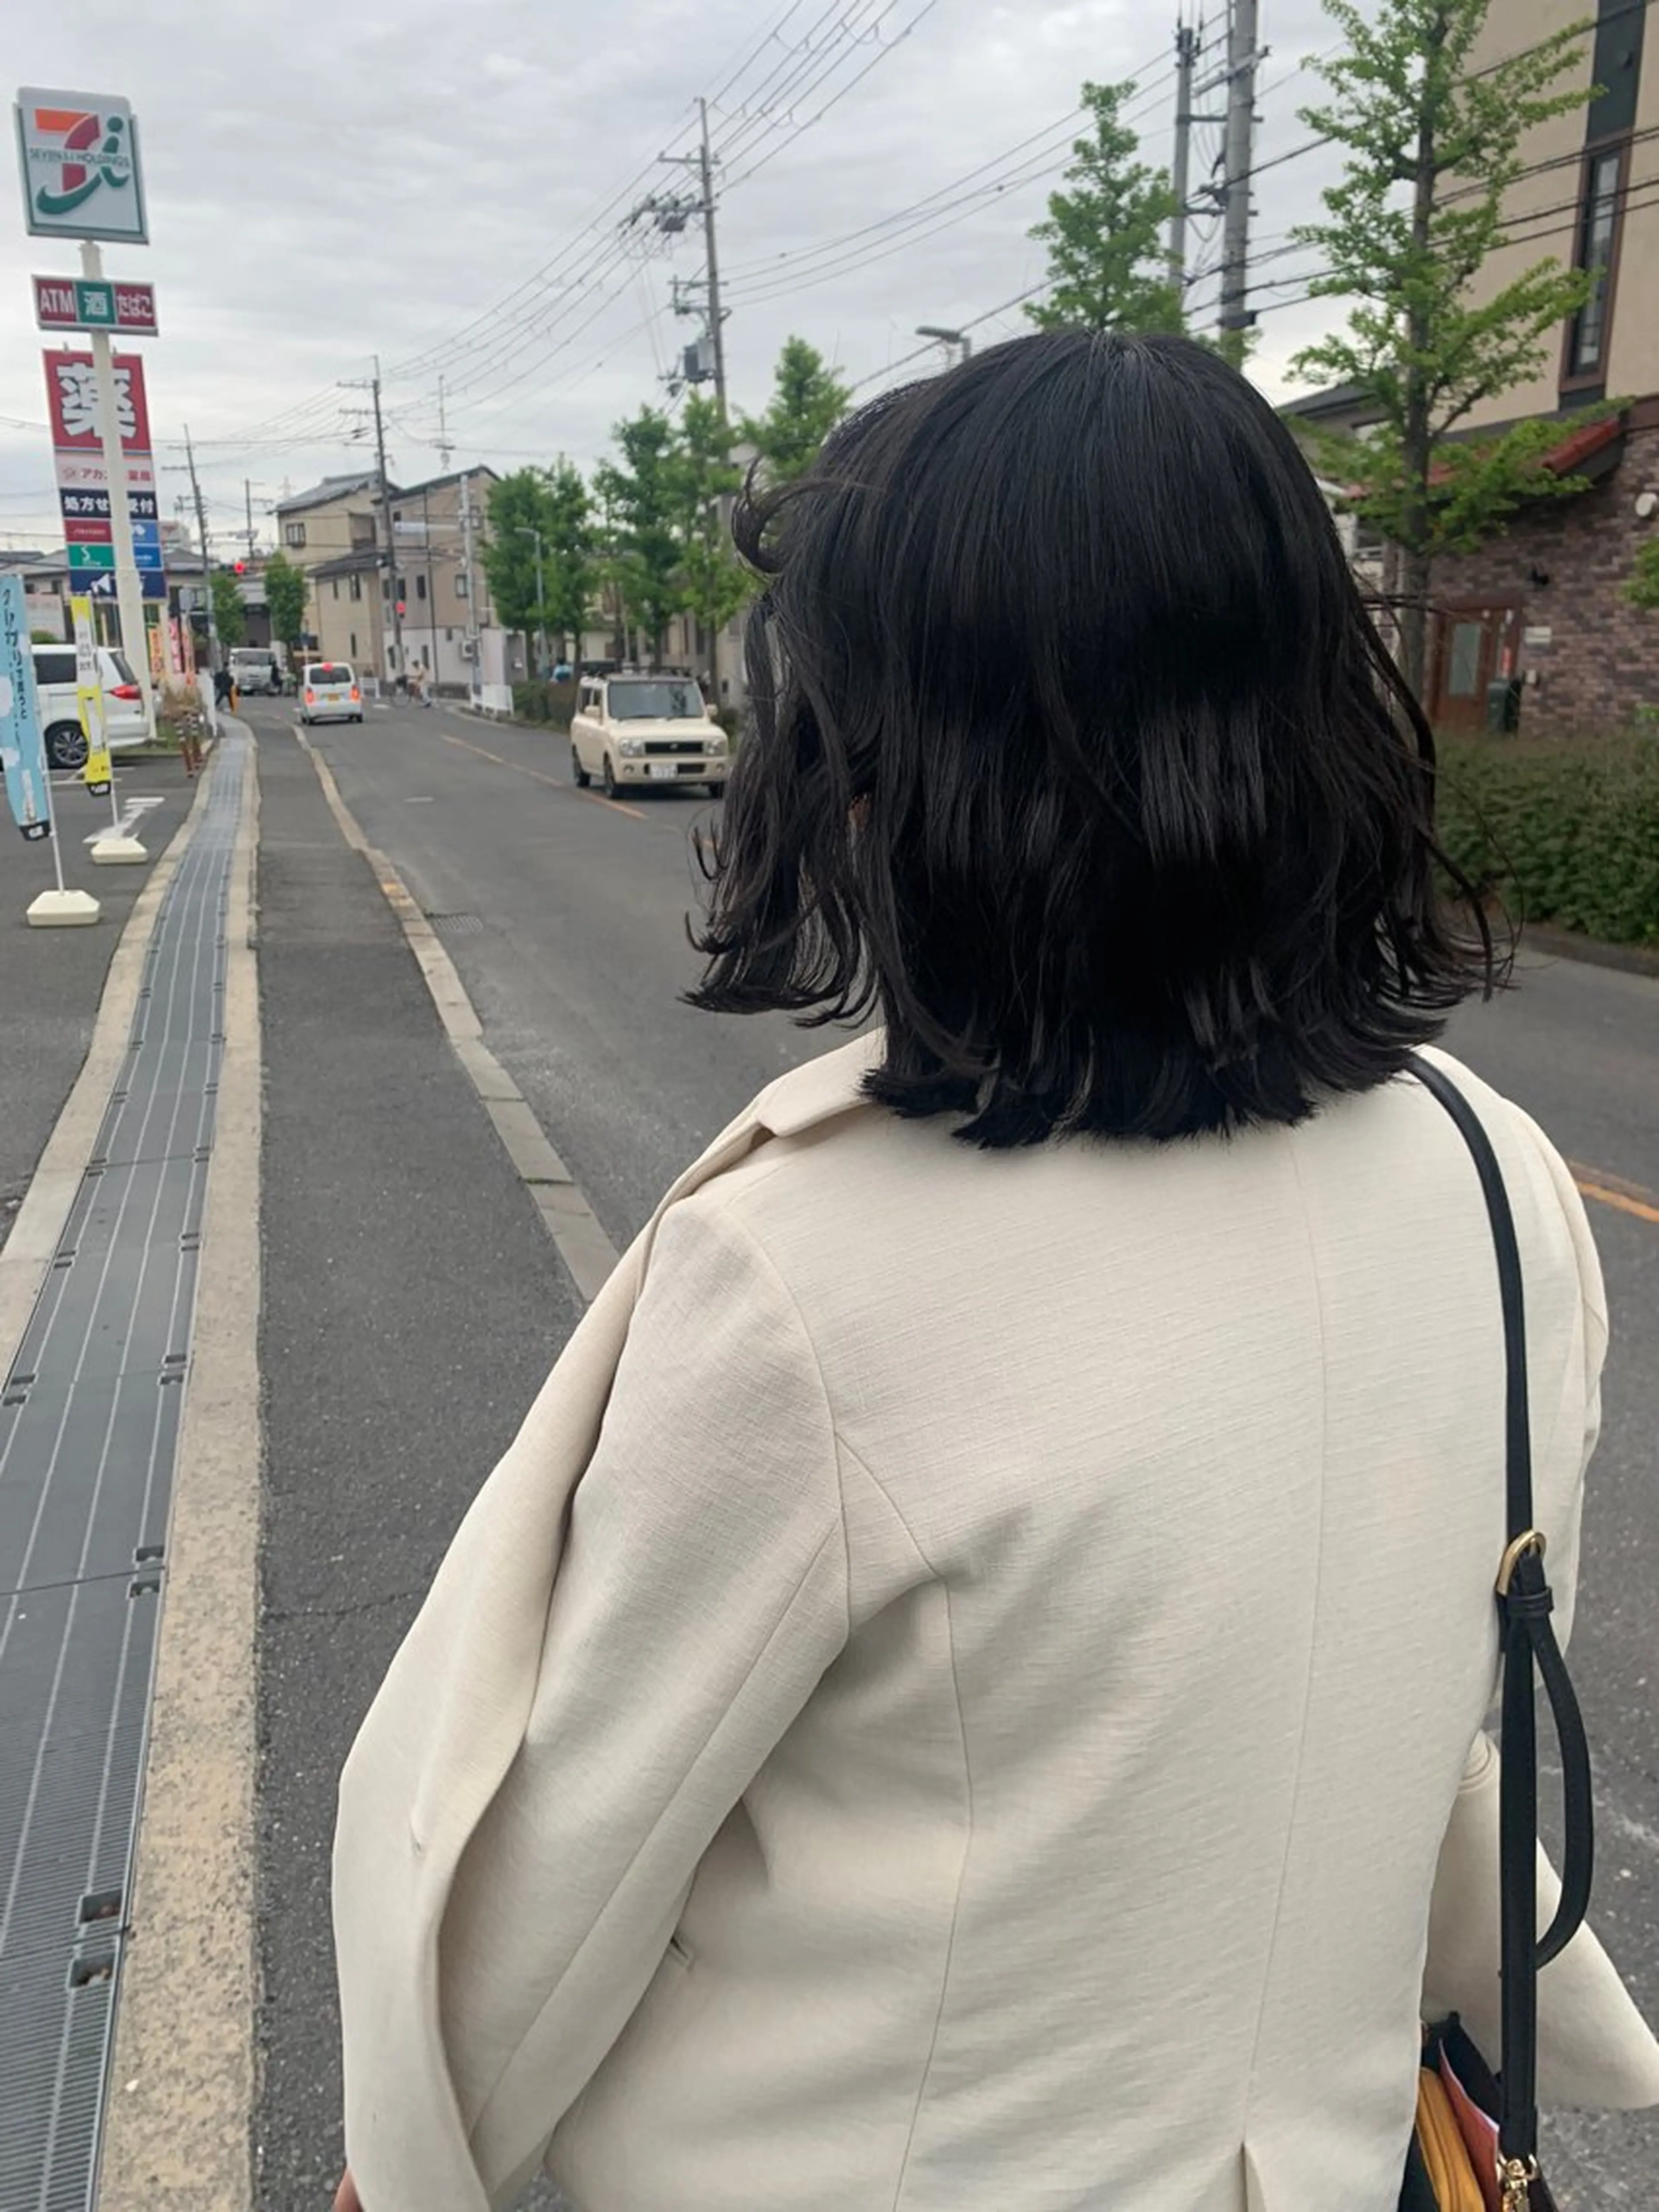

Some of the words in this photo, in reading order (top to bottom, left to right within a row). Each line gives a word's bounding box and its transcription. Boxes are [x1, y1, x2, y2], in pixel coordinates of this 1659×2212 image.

[40, 288, 74, 313] ATM
[84, 292, 108, 316] 酒
[118, 292, 153, 317] たばこ
